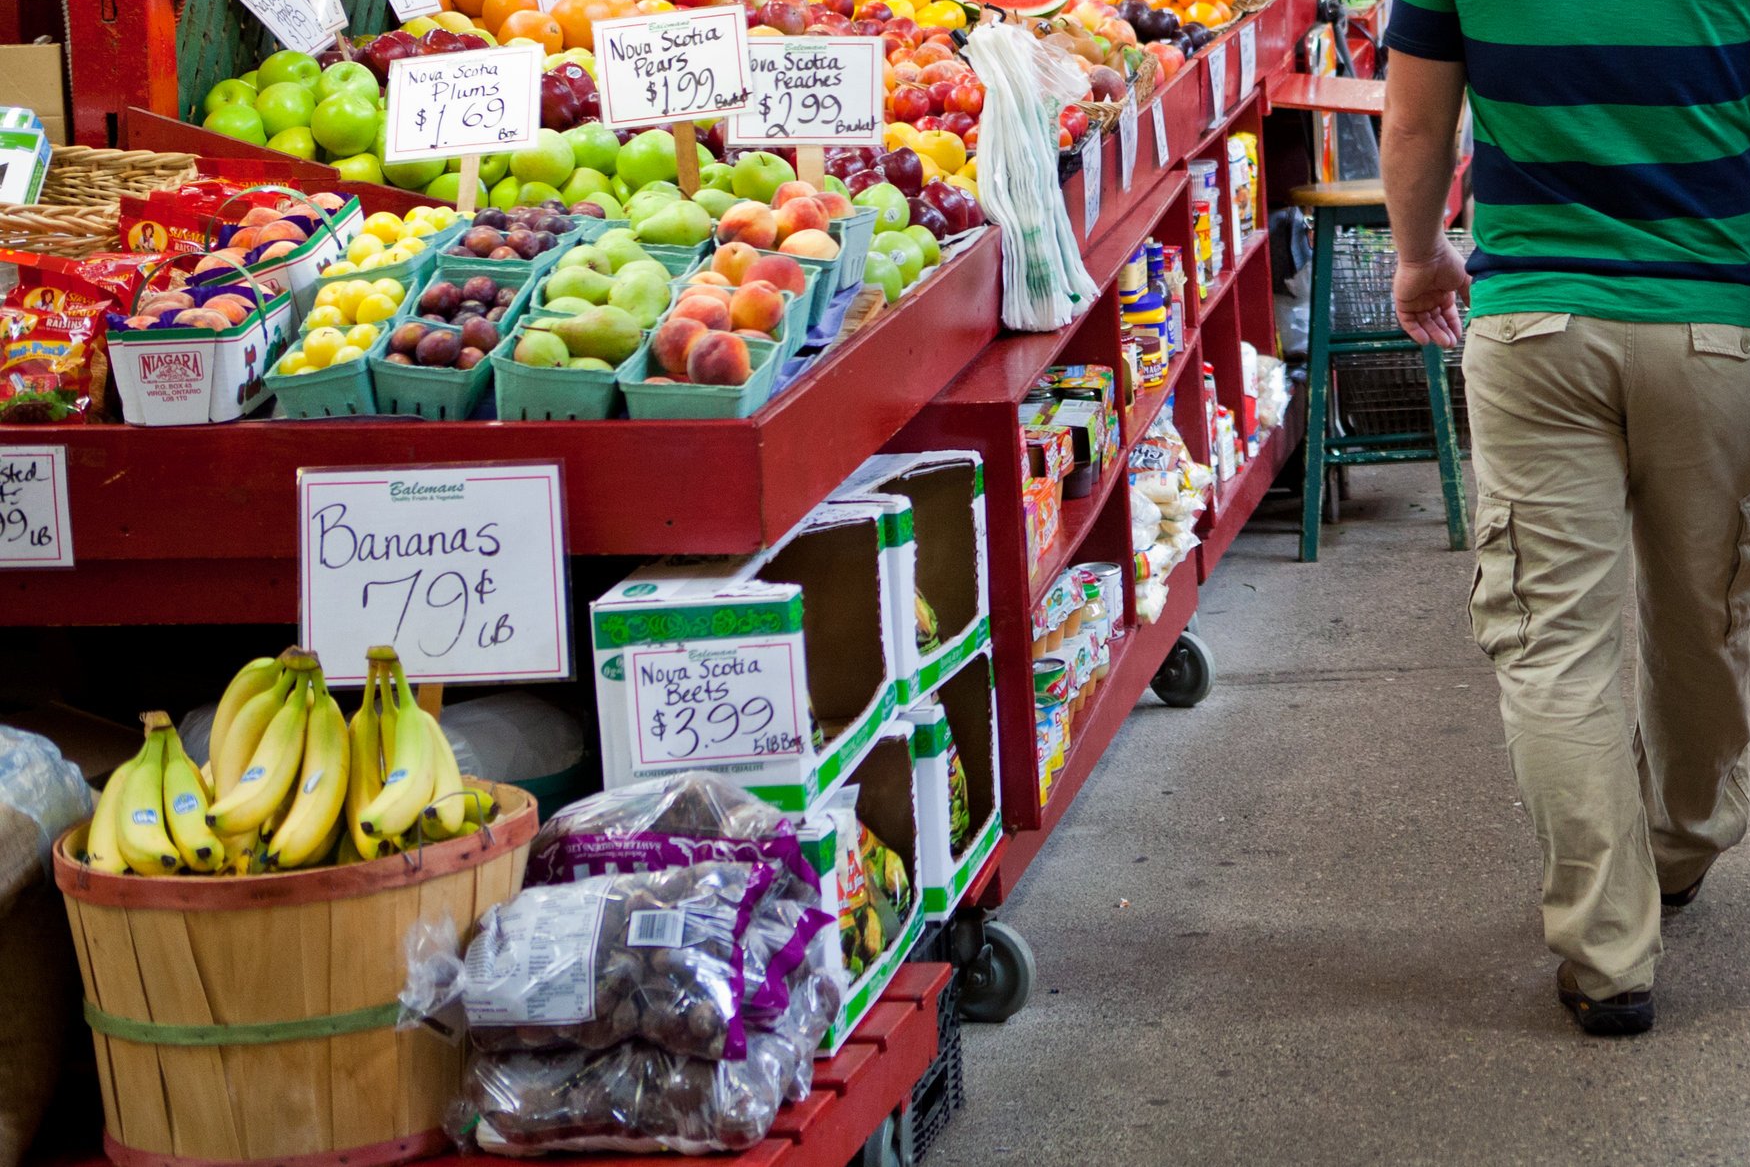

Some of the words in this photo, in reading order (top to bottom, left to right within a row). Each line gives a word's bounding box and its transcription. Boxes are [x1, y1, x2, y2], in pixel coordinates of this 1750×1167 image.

[610, 33, 652, 62] Nova
[661, 26, 725, 52] Scotia
[634, 51, 689, 79] Pears
[748, 50, 777, 72] ova
[784, 50, 846, 72] Scotia
[409, 70, 443, 85] Nova
[453, 63, 498, 79] Scotia
[774, 71, 842, 91] Peaches
[432, 81, 500, 102] Plums
[645, 67, 716, 116] $1.99
[759, 91, 842, 139] $2.99
[168, 227, 219, 245] SUN-MAD
[46, 317, 85, 329] RAISINS
[140, 353, 202, 380] NIAGARA
[171, 388, 202, 396] ONTARIO
[389, 480, 465, 497] Balemans
[391, 494, 411, 502] Quality
[312, 503, 500, 569] Bananas
[362, 569, 497, 657] 79¢
[688, 648, 738, 661] Balemans
[641, 662, 691, 686] Nova
[699, 657, 762, 679] Scotia
[664, 681, 729, 706] Beets
[651, 696, 774, 758] $3.99
